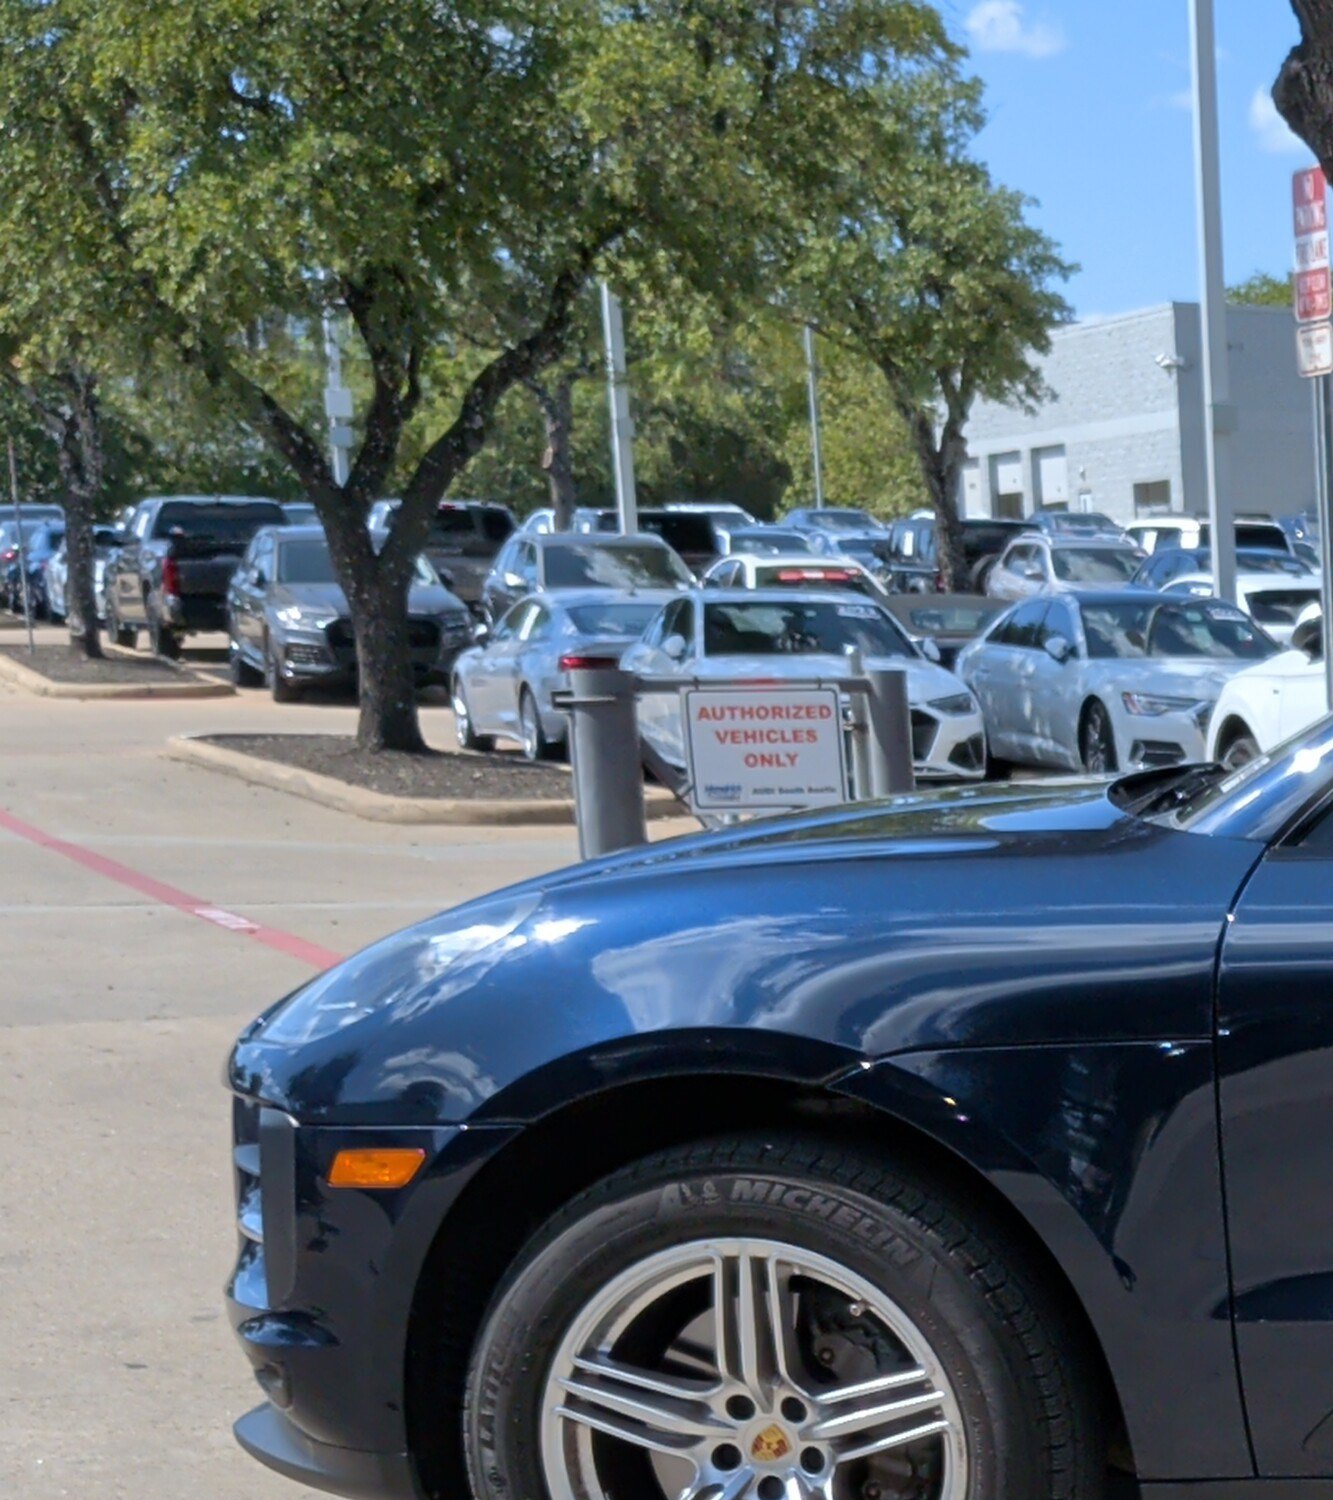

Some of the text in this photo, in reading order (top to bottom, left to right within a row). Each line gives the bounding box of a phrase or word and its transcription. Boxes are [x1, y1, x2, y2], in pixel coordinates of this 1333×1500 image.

[697, 704, 832, 721] AUTHORIZED
[714, 729, 818, 745] VEHICLES
[744, 752, 799, 769] ONLY
[730, 1179, 922, 1265] MICHELIN
